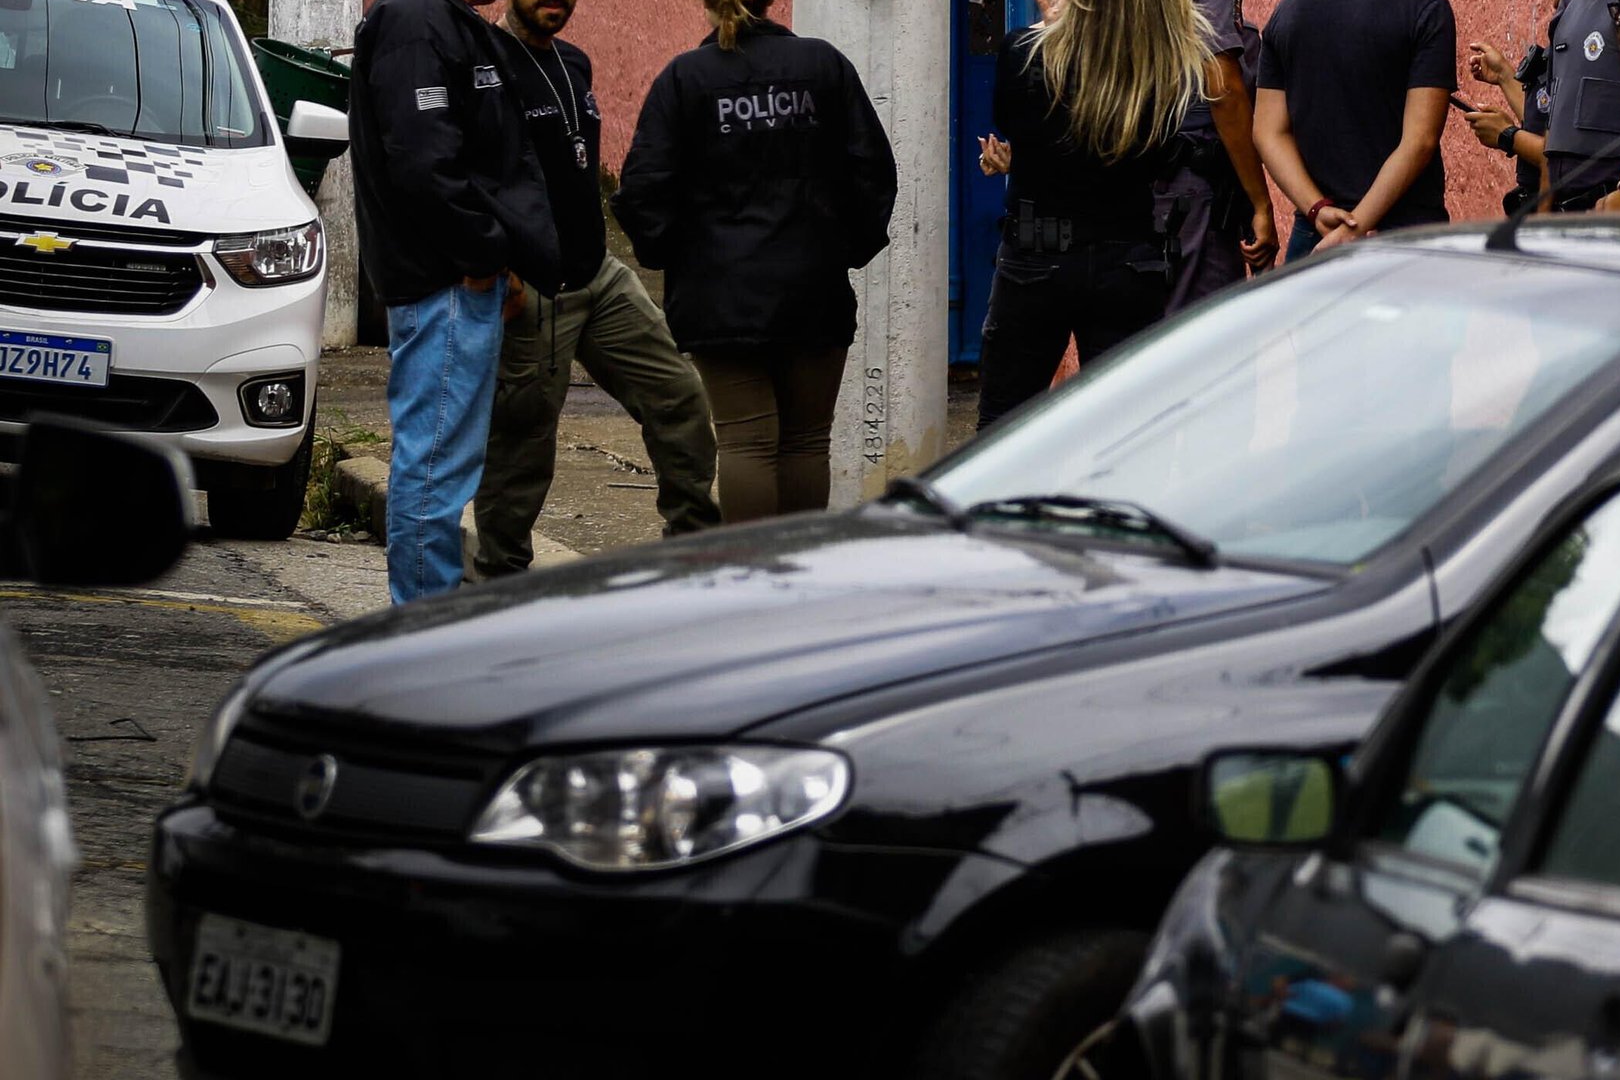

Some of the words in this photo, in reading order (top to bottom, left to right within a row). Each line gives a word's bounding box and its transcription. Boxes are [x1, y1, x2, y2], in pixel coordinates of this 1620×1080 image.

[717, 85, 817, 122] POLÍCIA
[720, 115, 819, 134] CIVIL
[0, 180, 171, 224] LÍCIA
[26, 335, 49, 345] BRASIL
[863, 367, 885, 465] 484226
